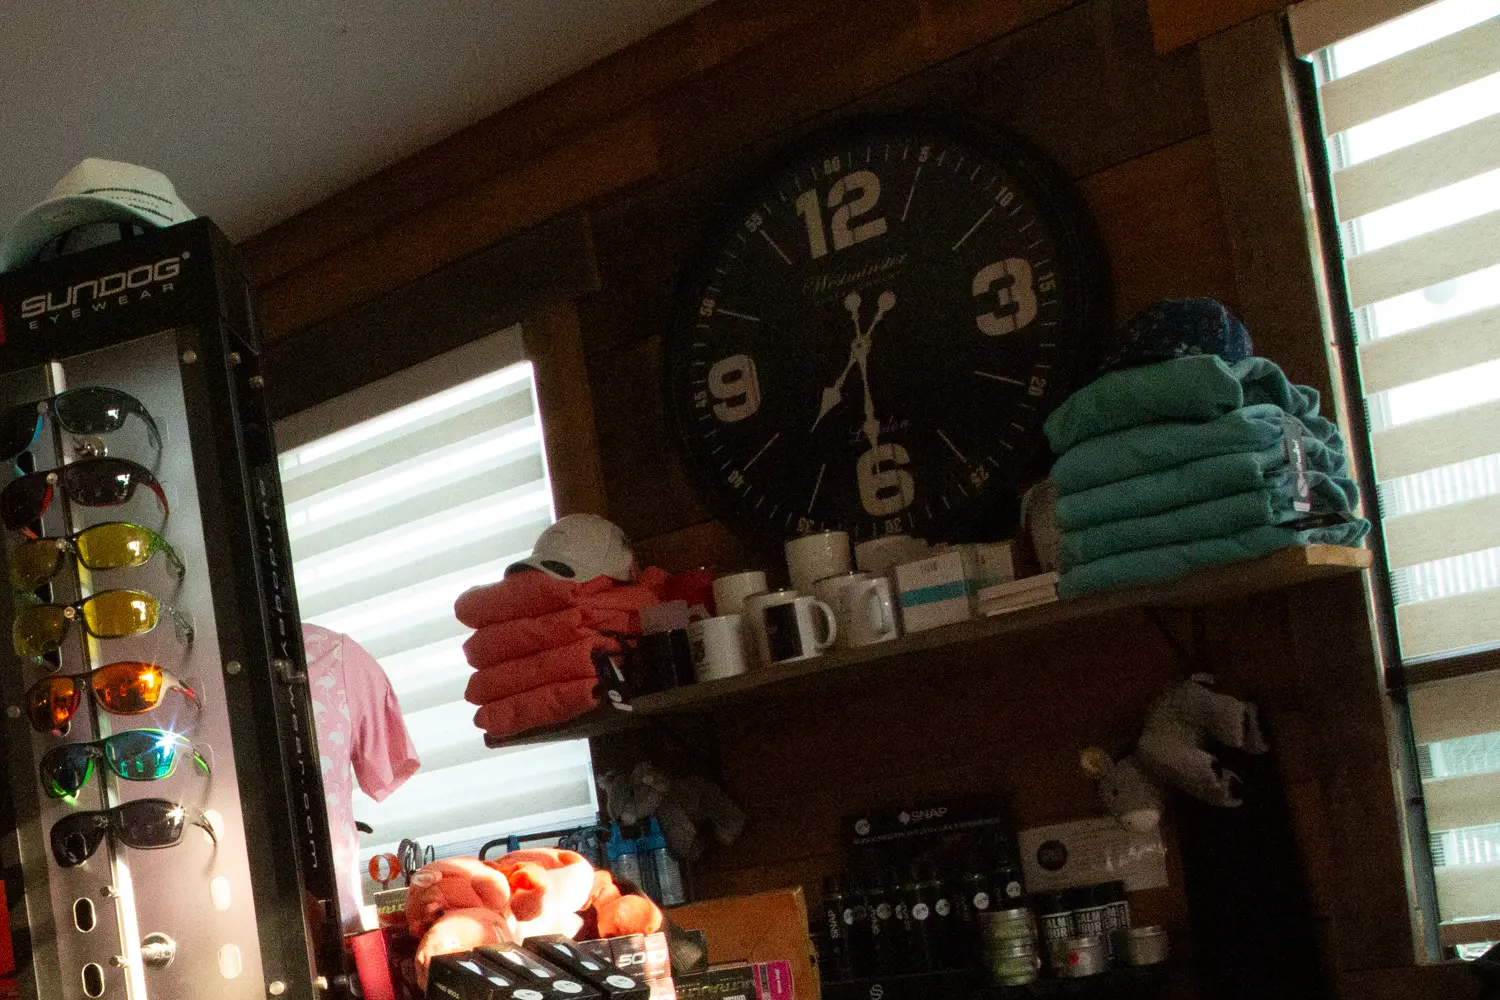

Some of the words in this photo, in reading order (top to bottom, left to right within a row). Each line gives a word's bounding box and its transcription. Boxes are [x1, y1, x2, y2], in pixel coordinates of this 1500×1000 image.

[794, 168, 890, 260] 12
[21, 256, 181, 319] SUNDOG
[28, 282, 175, 331] EYEWEAR
[970, 255, 1040, 337] 3
[707, 352, 763, 424] 9
[855, 441, 917, 518] 6
